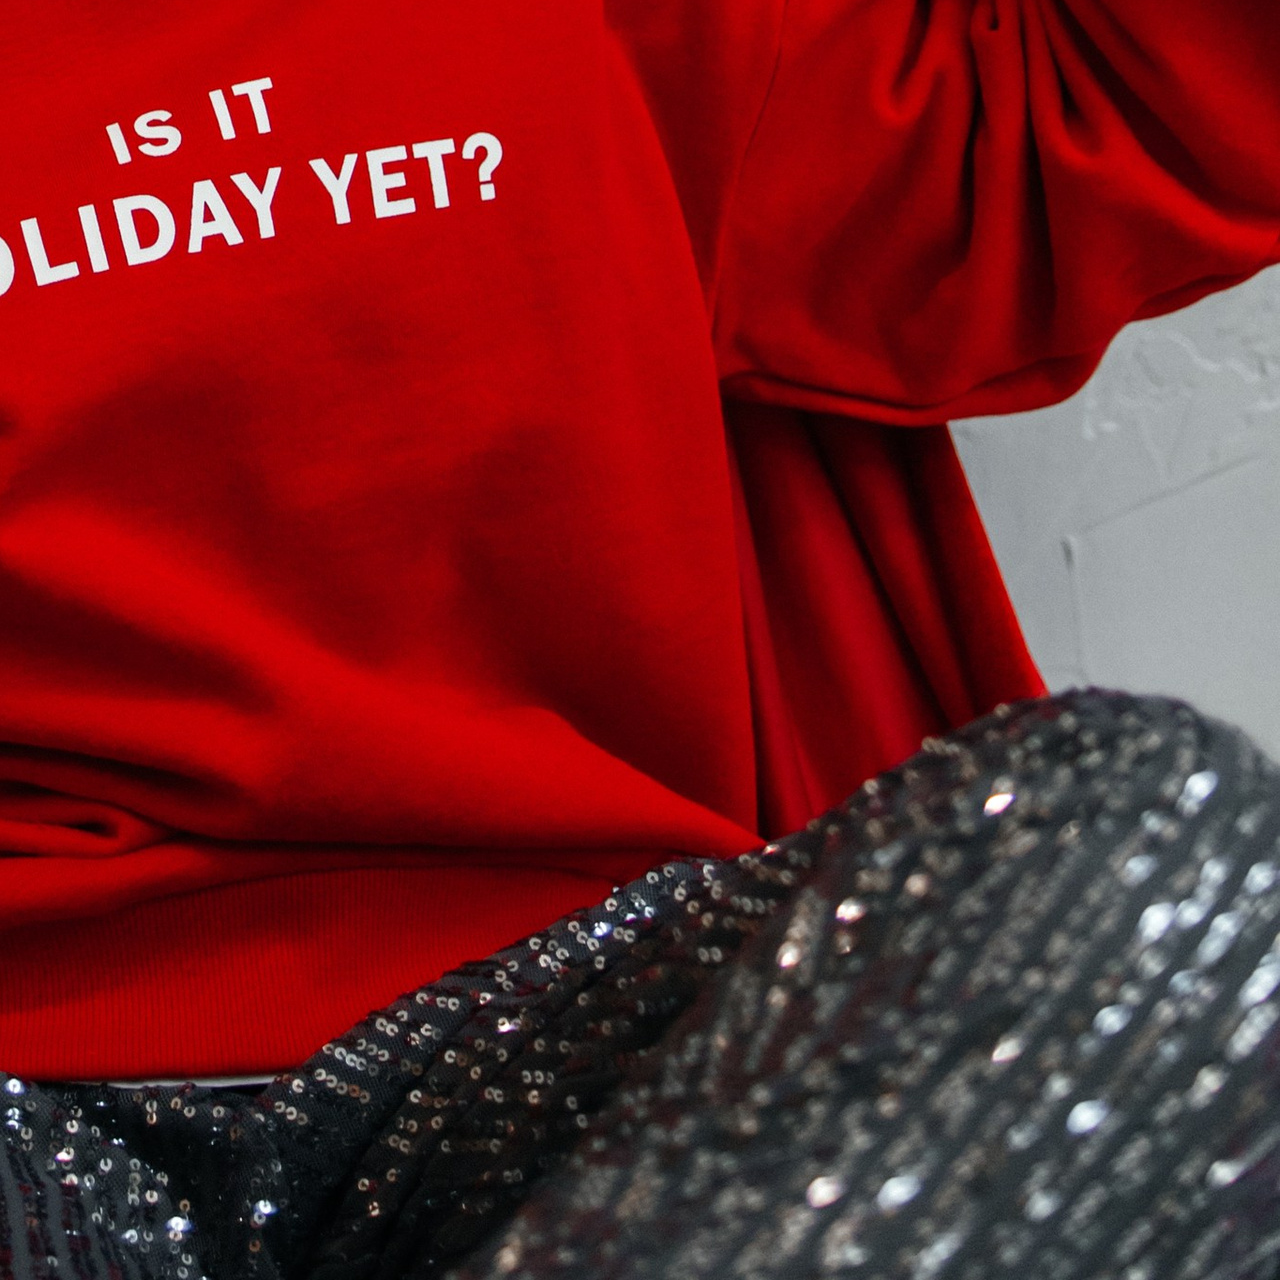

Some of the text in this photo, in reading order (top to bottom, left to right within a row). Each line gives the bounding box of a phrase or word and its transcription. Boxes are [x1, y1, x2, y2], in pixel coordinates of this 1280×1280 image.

[105, 76, 274, 165] IS IT
[308, 131, 504, 226] YET?
